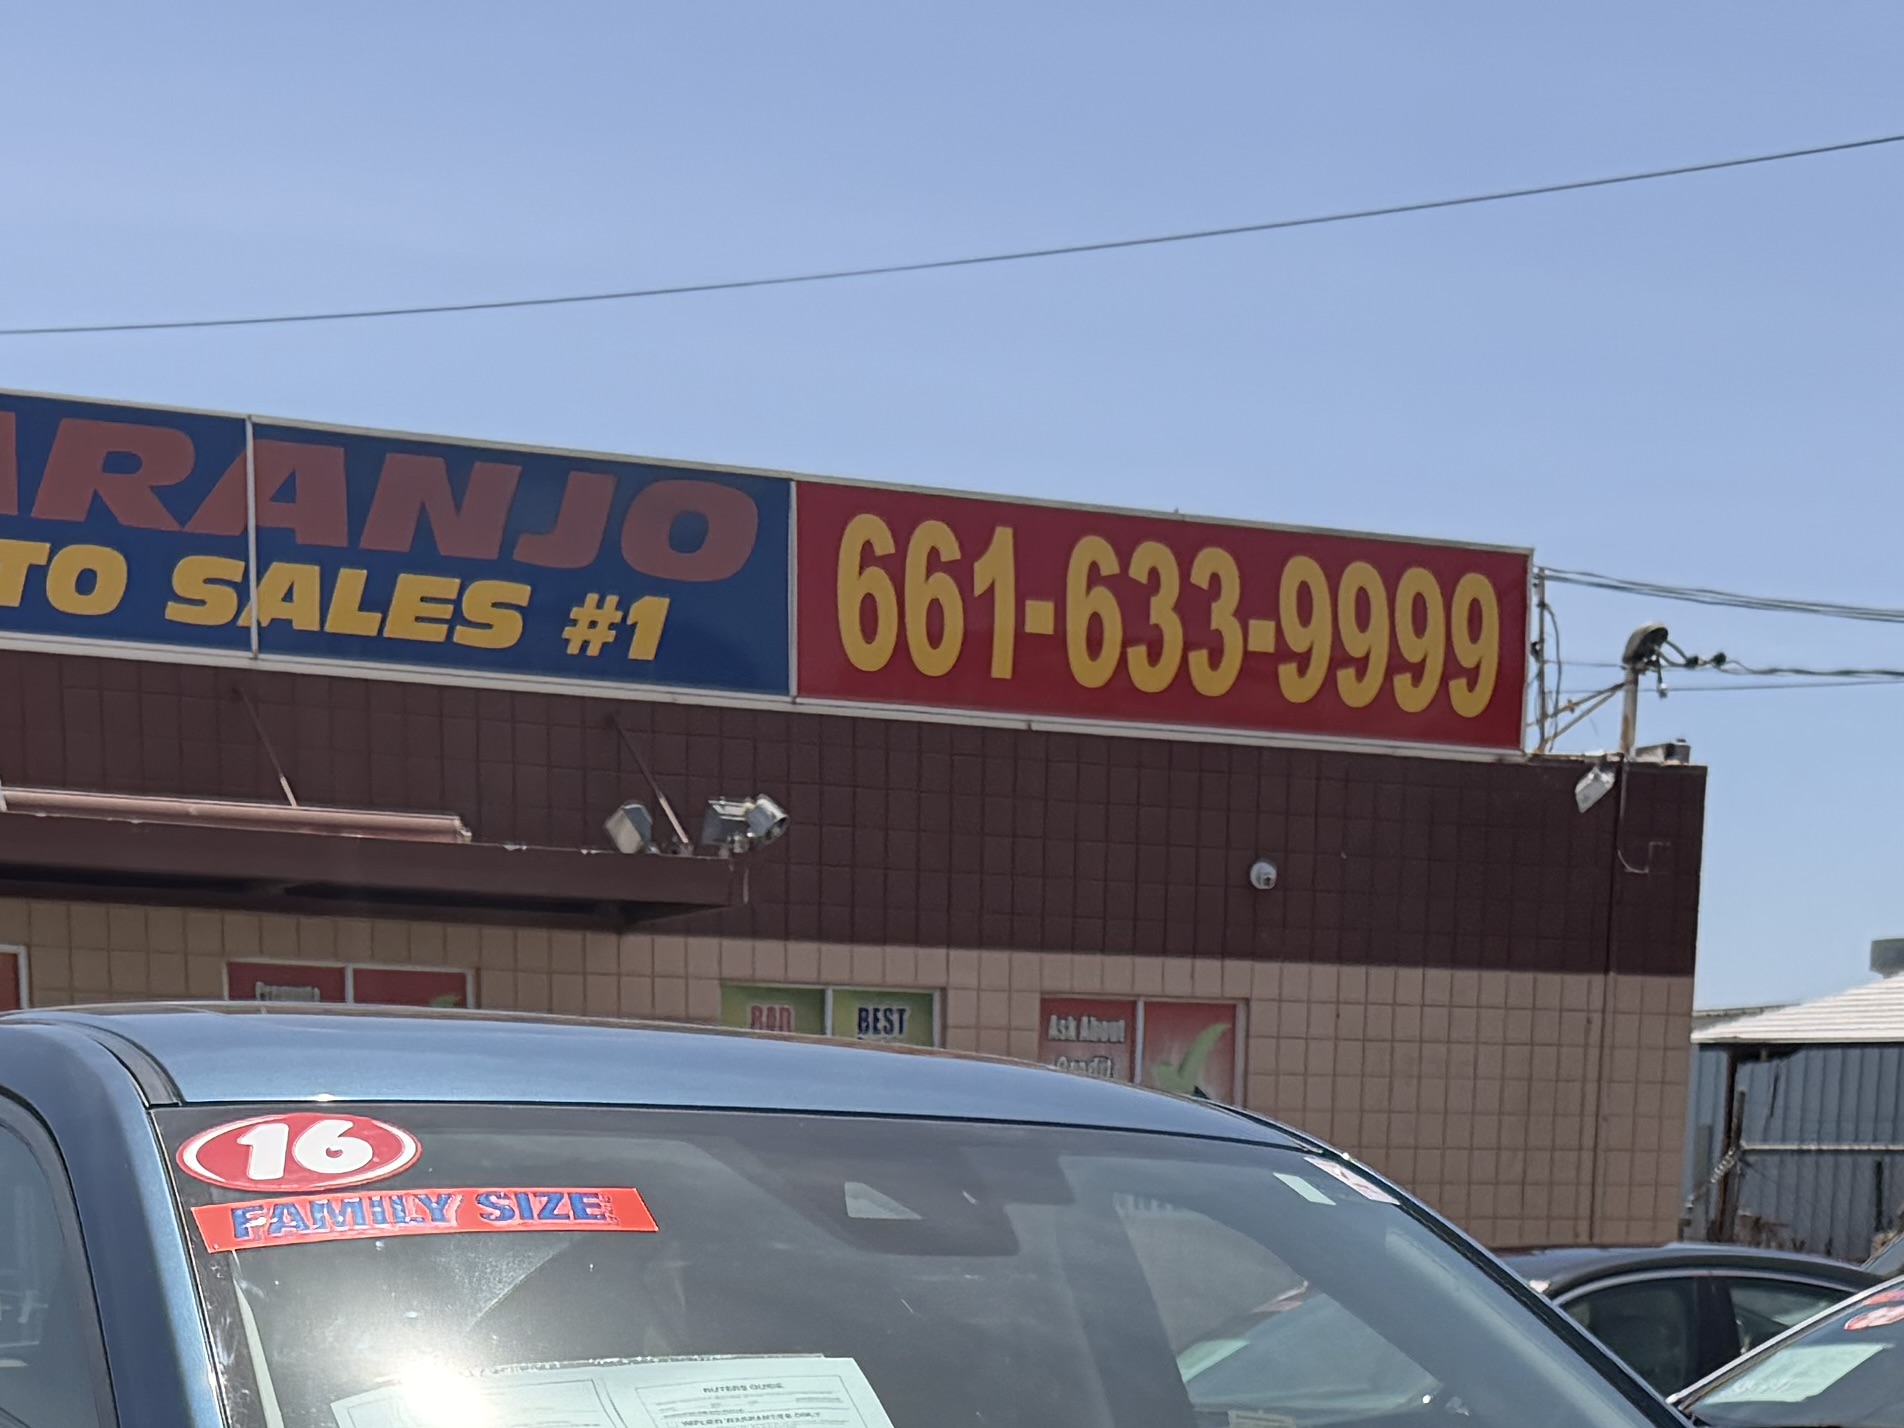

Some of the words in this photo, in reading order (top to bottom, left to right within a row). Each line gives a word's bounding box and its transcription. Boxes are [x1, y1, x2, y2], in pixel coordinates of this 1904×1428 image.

[164, 553, 530, 649] SALES
[561, 592, 670, 661] #1
[837, 512, 1499, 718] 661-633-9999
[857, 1006, 908, 1036] BEST
[236, 1118, 374, 1181] 16
[231, 1192, 463, 1241] FAMILY
[476, 1190, 609, 1225] SIZE
